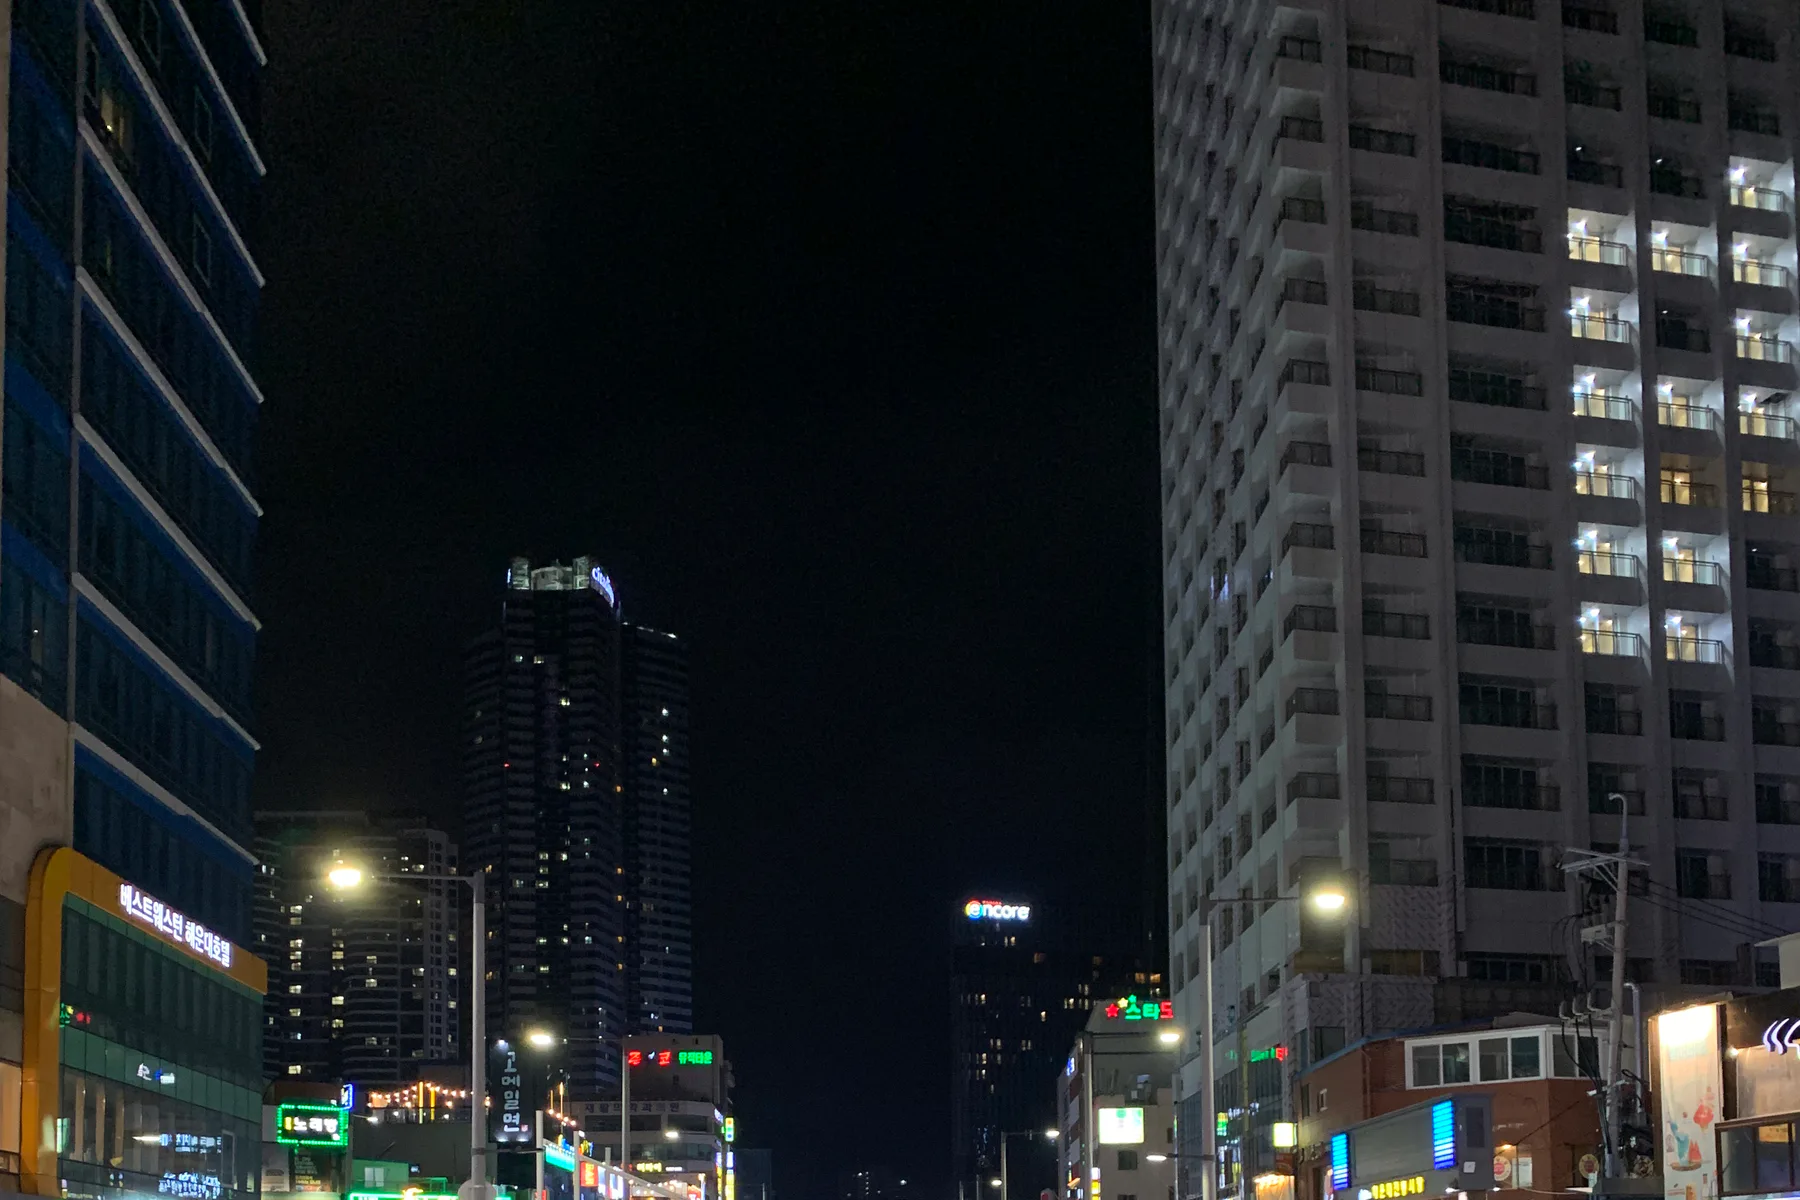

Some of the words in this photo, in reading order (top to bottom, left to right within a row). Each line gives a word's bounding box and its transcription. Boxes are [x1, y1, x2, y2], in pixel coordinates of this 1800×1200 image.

[965, 900, 1030, 920] encore
[185, 920, 230, 967] 해운대호텔
[678, 1051, 713, 1065] 뮤직타운
